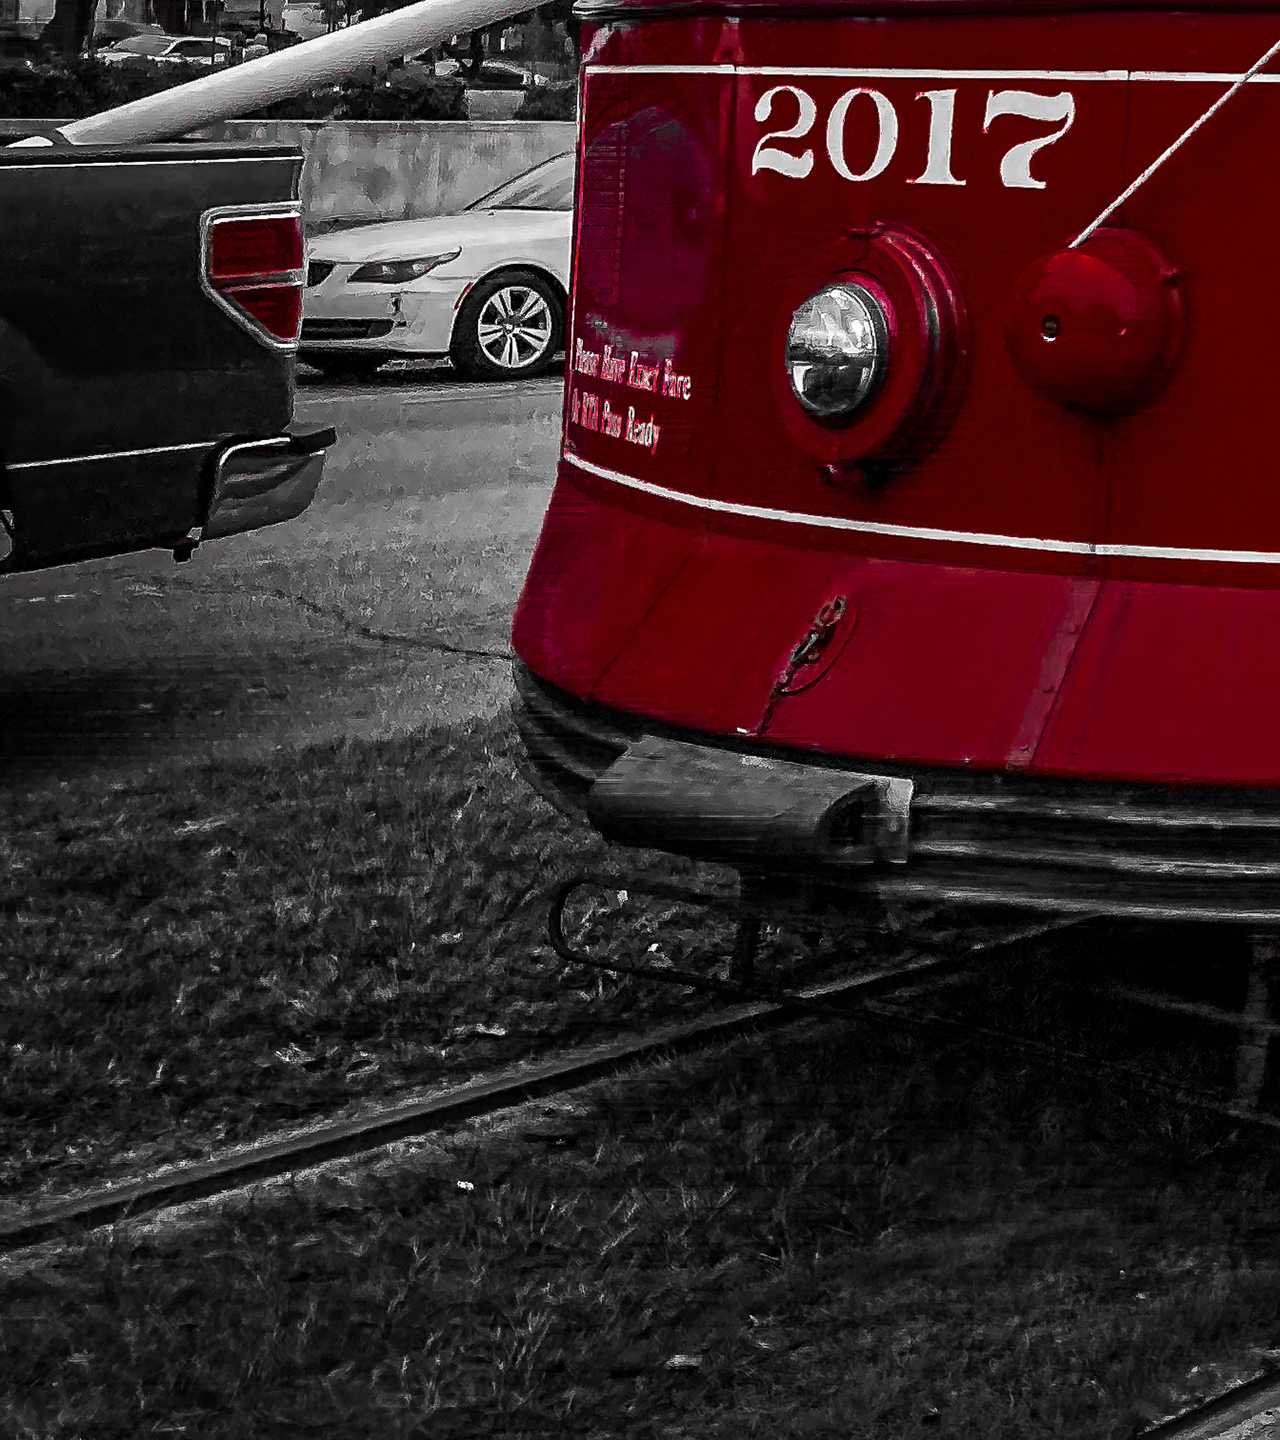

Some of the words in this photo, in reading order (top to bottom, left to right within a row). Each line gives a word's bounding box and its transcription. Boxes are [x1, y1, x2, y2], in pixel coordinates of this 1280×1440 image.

[752, 85, 1075, 189] 2017
[601, 344, 626, 384] Have
[626, 350, 660, 393] Exact
[661, 358, 692, 400] Fare
[600, 398, 622, 440] Pass
[625, 405, 661, 456] Ready
